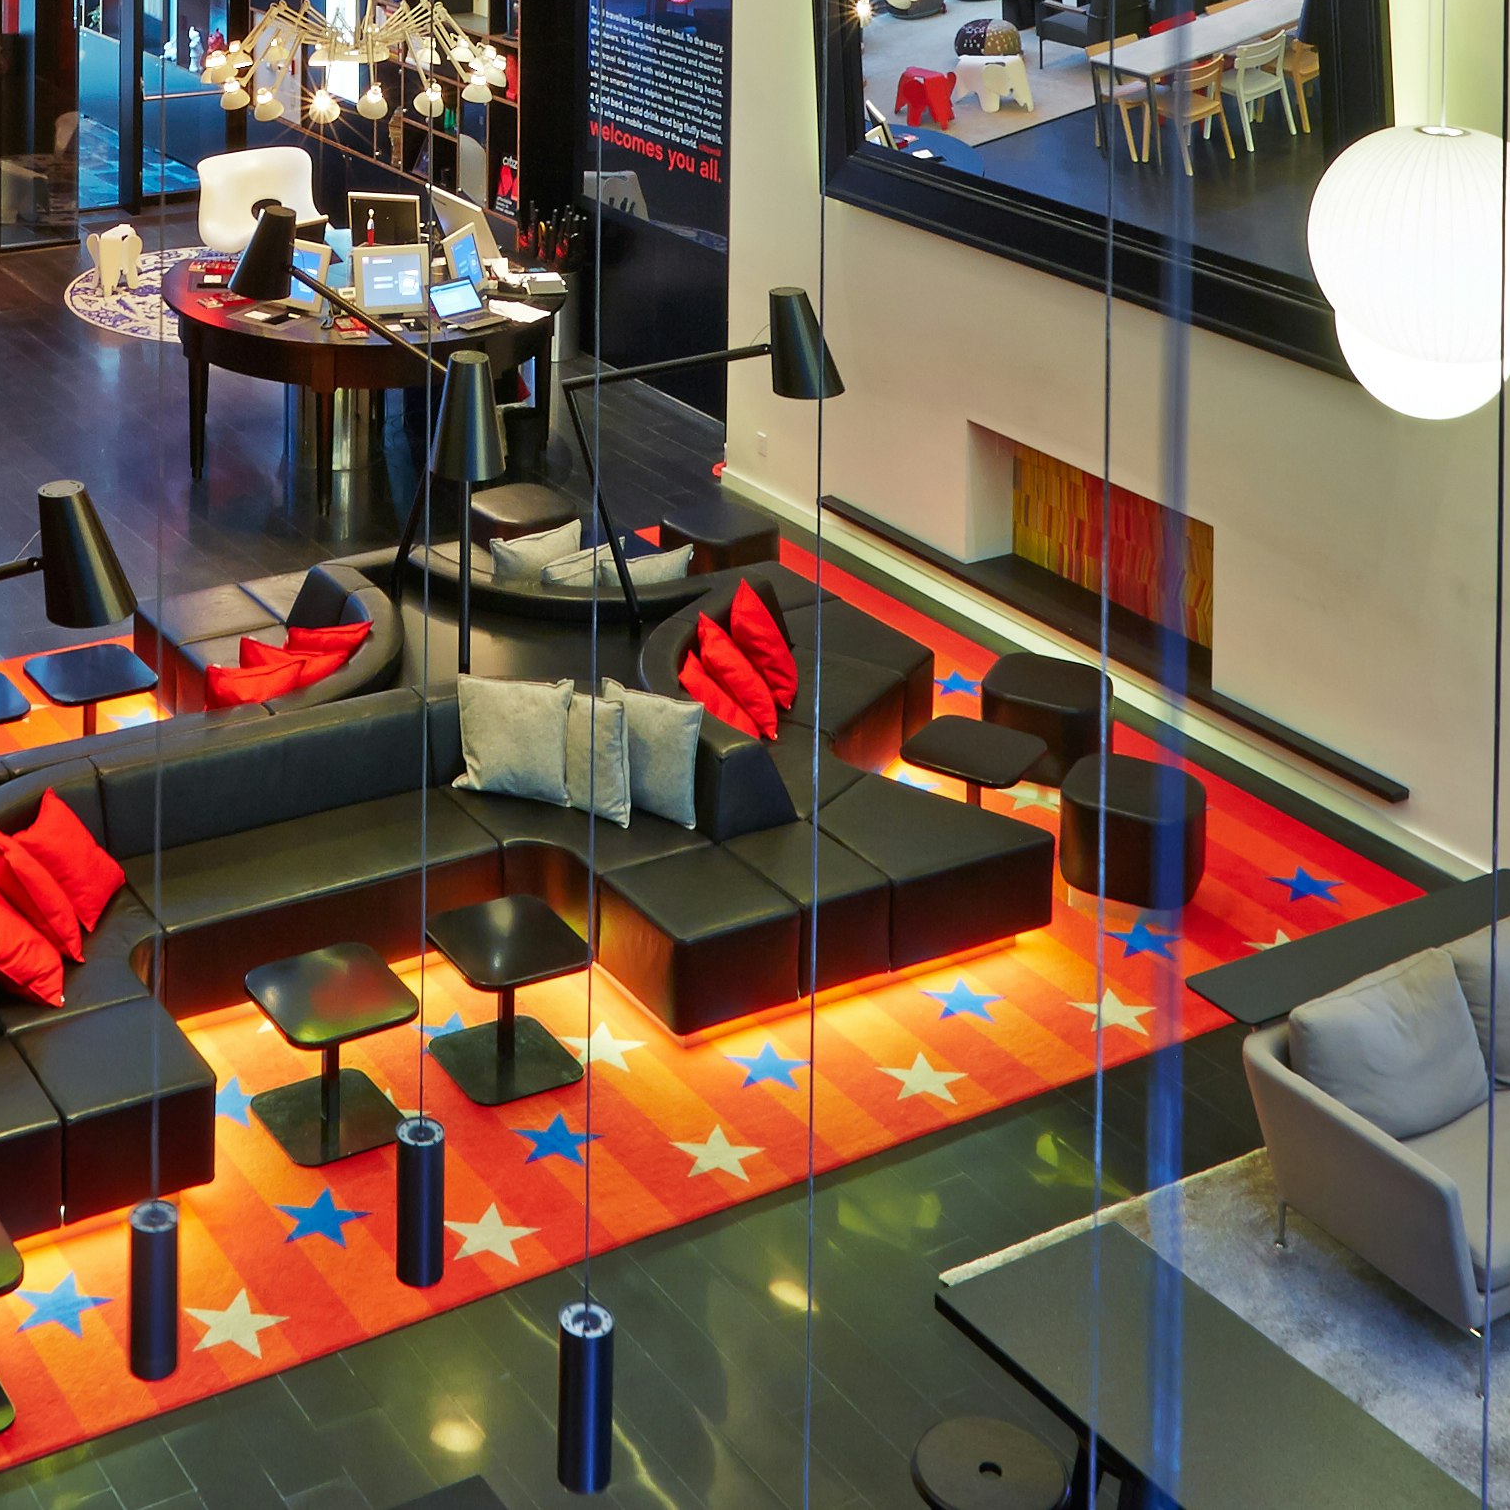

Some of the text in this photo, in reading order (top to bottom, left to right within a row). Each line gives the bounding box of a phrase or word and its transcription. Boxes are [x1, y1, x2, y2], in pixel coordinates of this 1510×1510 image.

[590, 120, 722, 184] welcomes you all.
